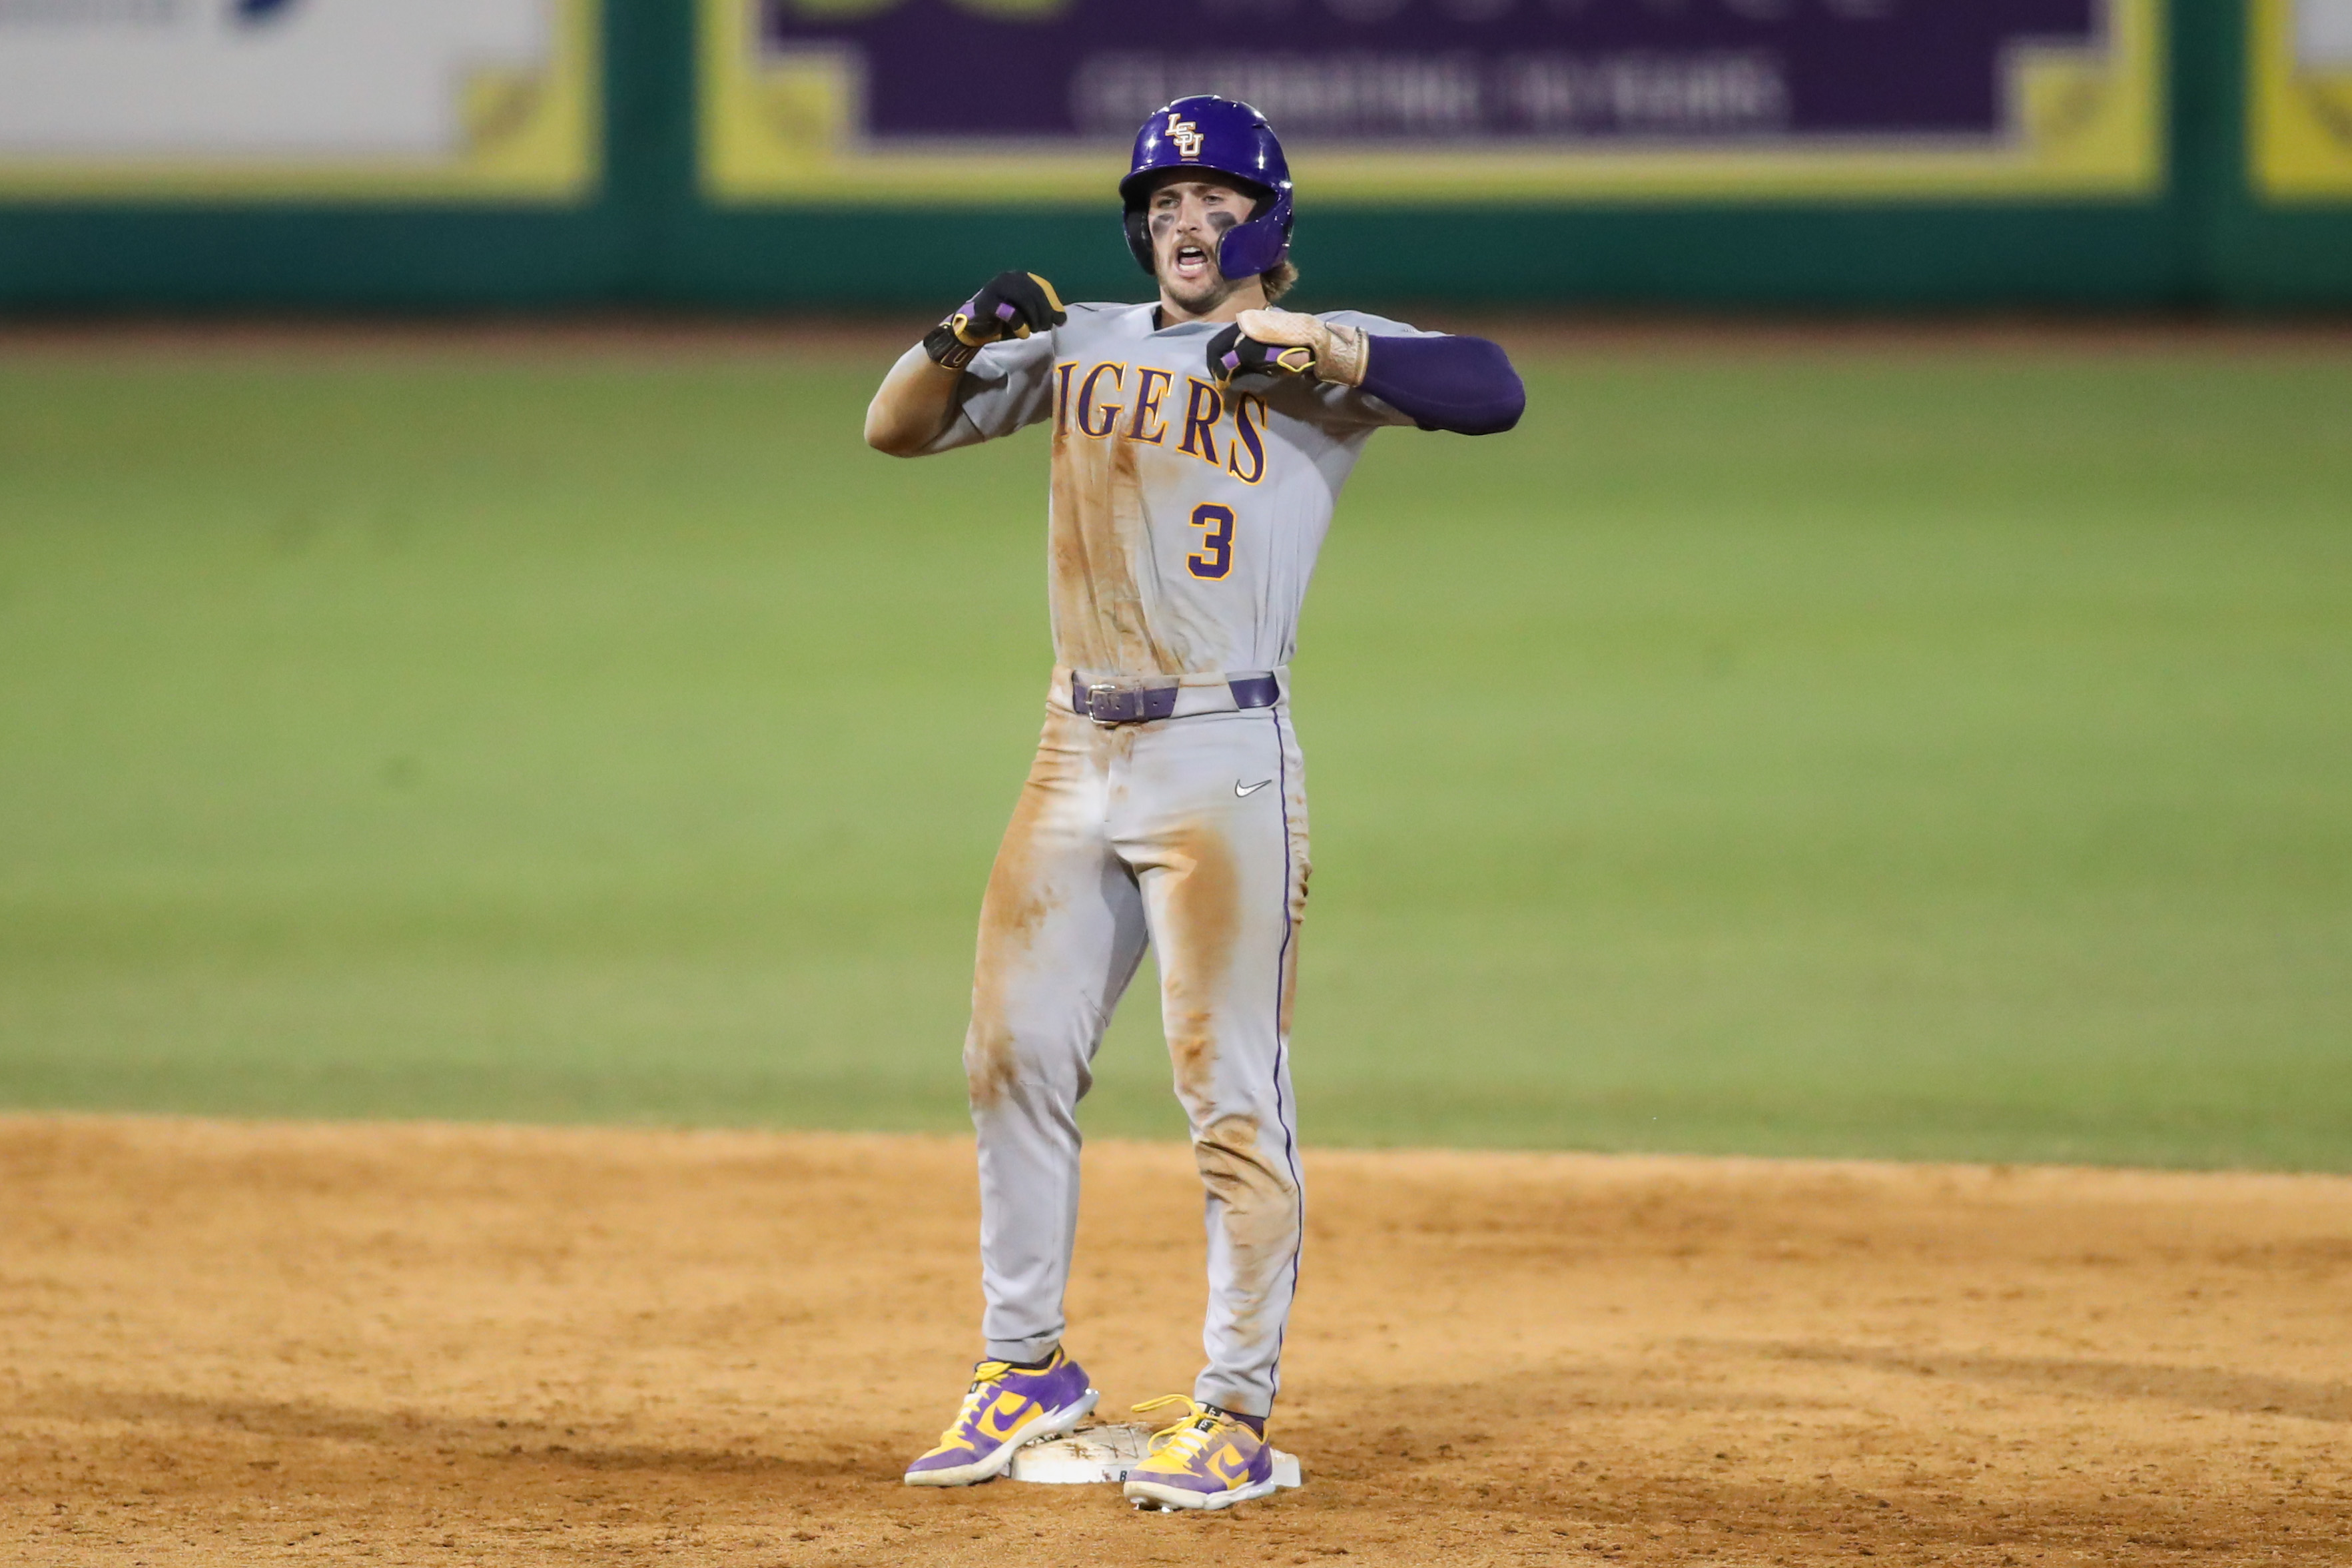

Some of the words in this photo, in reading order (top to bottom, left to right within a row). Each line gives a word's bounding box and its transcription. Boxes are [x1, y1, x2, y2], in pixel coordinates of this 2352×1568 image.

[1165, 113, 1204, 157] LSU
[1054, 360, 1268, 486] IGERS
[1186, 501, 1237, 581] 3
